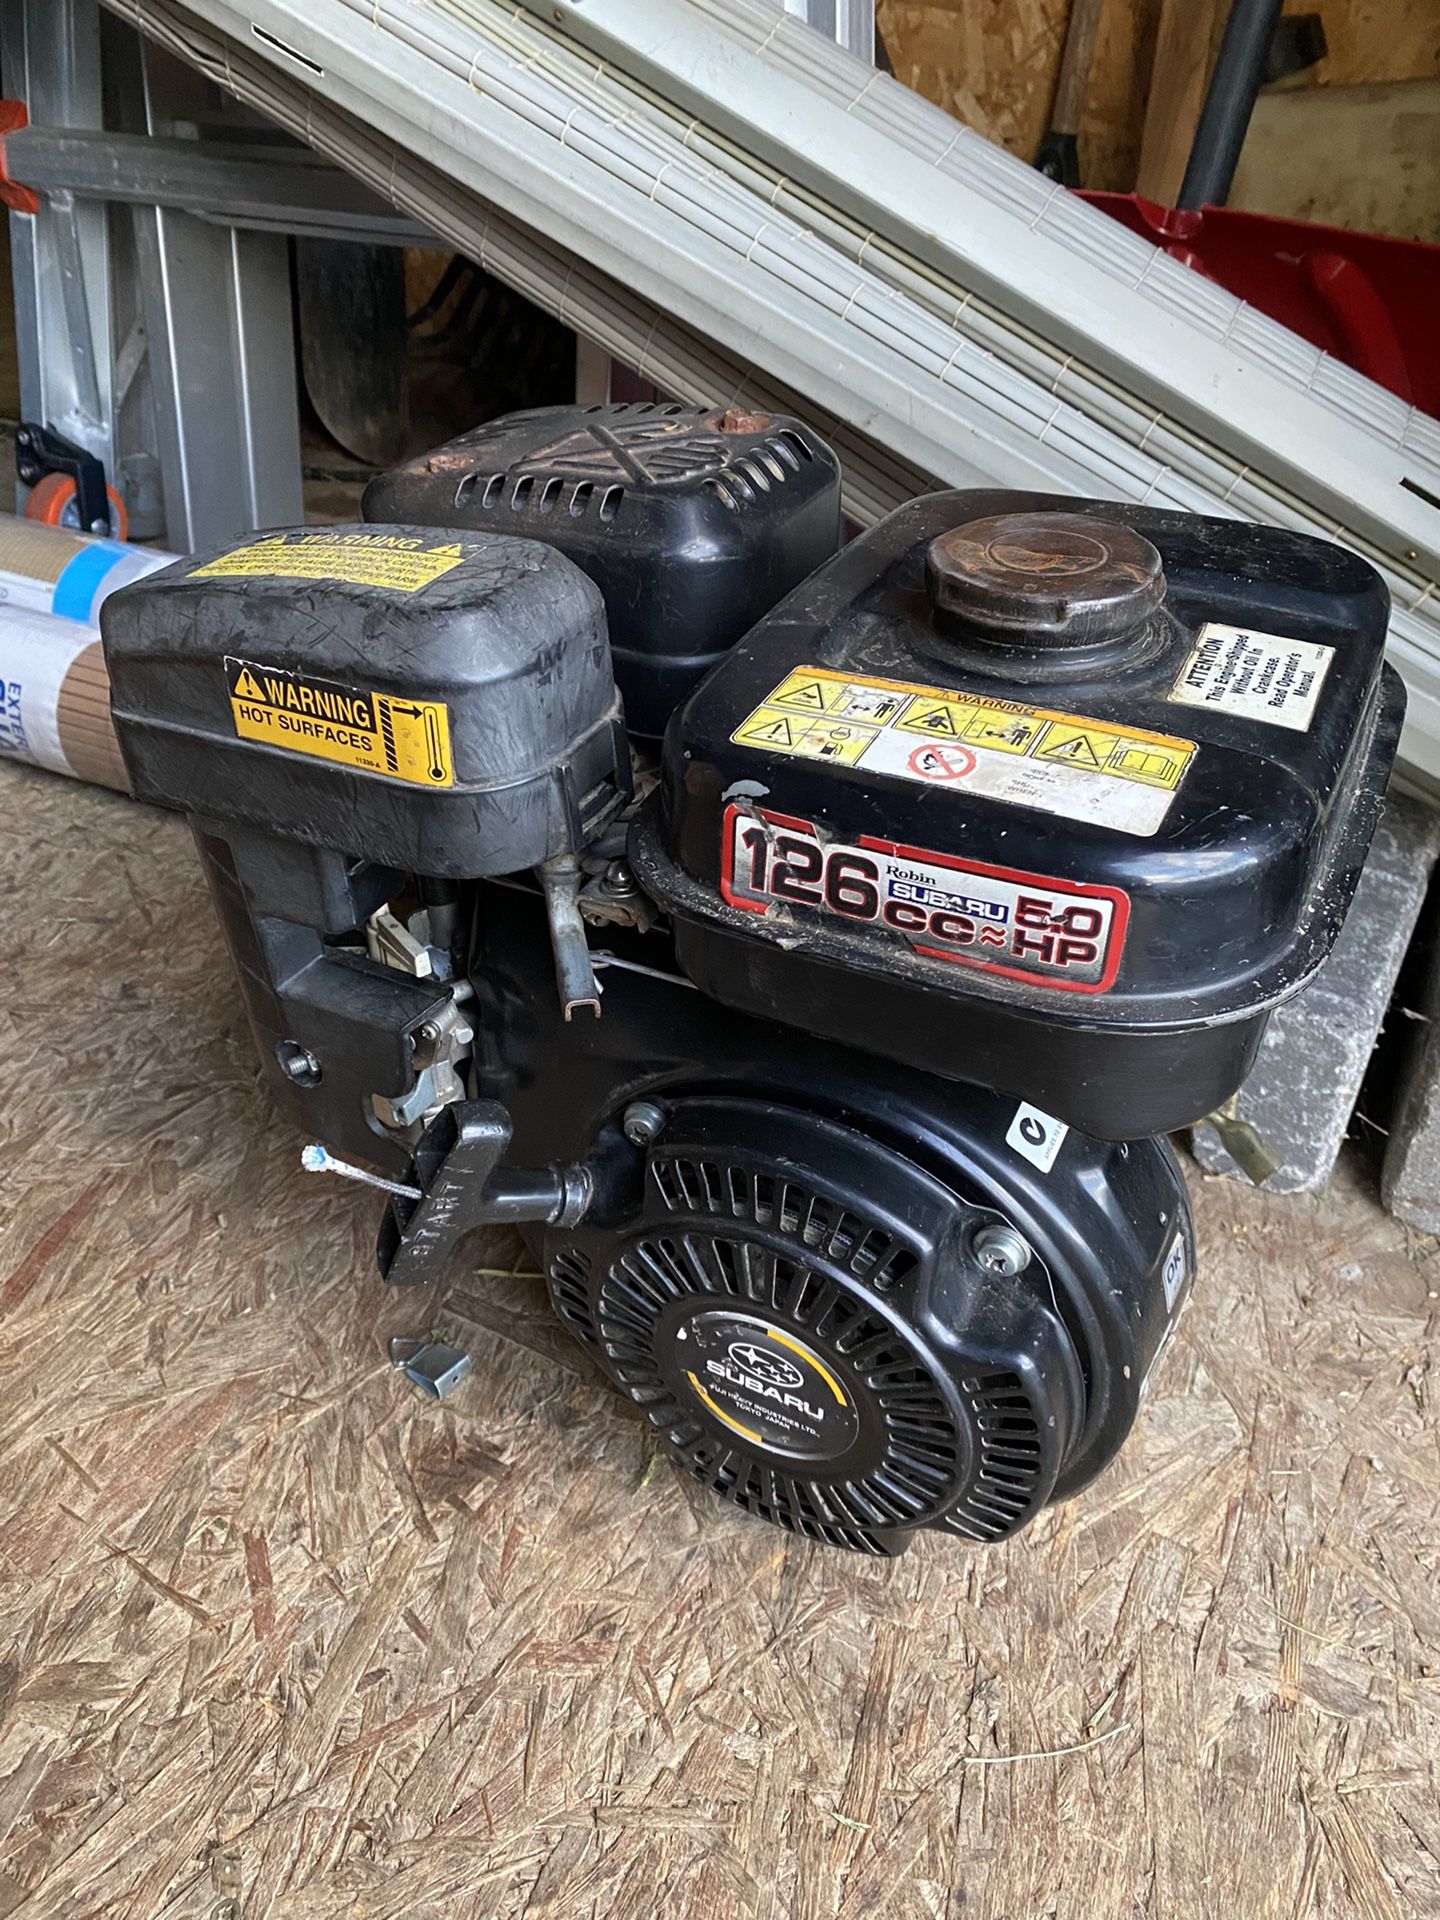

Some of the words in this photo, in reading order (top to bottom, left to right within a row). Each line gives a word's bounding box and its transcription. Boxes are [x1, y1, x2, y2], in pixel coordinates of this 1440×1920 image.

[301, 534, 424, 550] WARNING
[1185, 637, 1225, 688] ATTENTION
[1226, 634, 1250, 661] Shipped
[1214, 662, 1237, 686] Engine
[1230, 666, 1253, 695] Without
[1243, 654, 1259, 668] Oil
[1275, 652, 1302, 687] Operator's
[264, 677, 371, 728] WARNING
[957, 694, 1036, 715] WARNING
[1205, 686, 1226, 701] This
[1268, 684, 1288, 708] Read
[239, 704, 273, 726] HOT
[279, 714, 373, 752] SURFACES
[741, 827, 879, 921] 126
[886, 865, 936, 886] Robin
[893, 882, 1005, 920] SUBARU
[1011, 928, 1098, 967] HP
[1167, 1246, 1181, 1284] OK
[706, 1359, 824, 1420] SUBARU
[735, 1401, 762, 1416] TOKYO
[765, 1414, 791, 1430] JAPAN
[754, 1403, 800, 1429] INDUSTRIES
